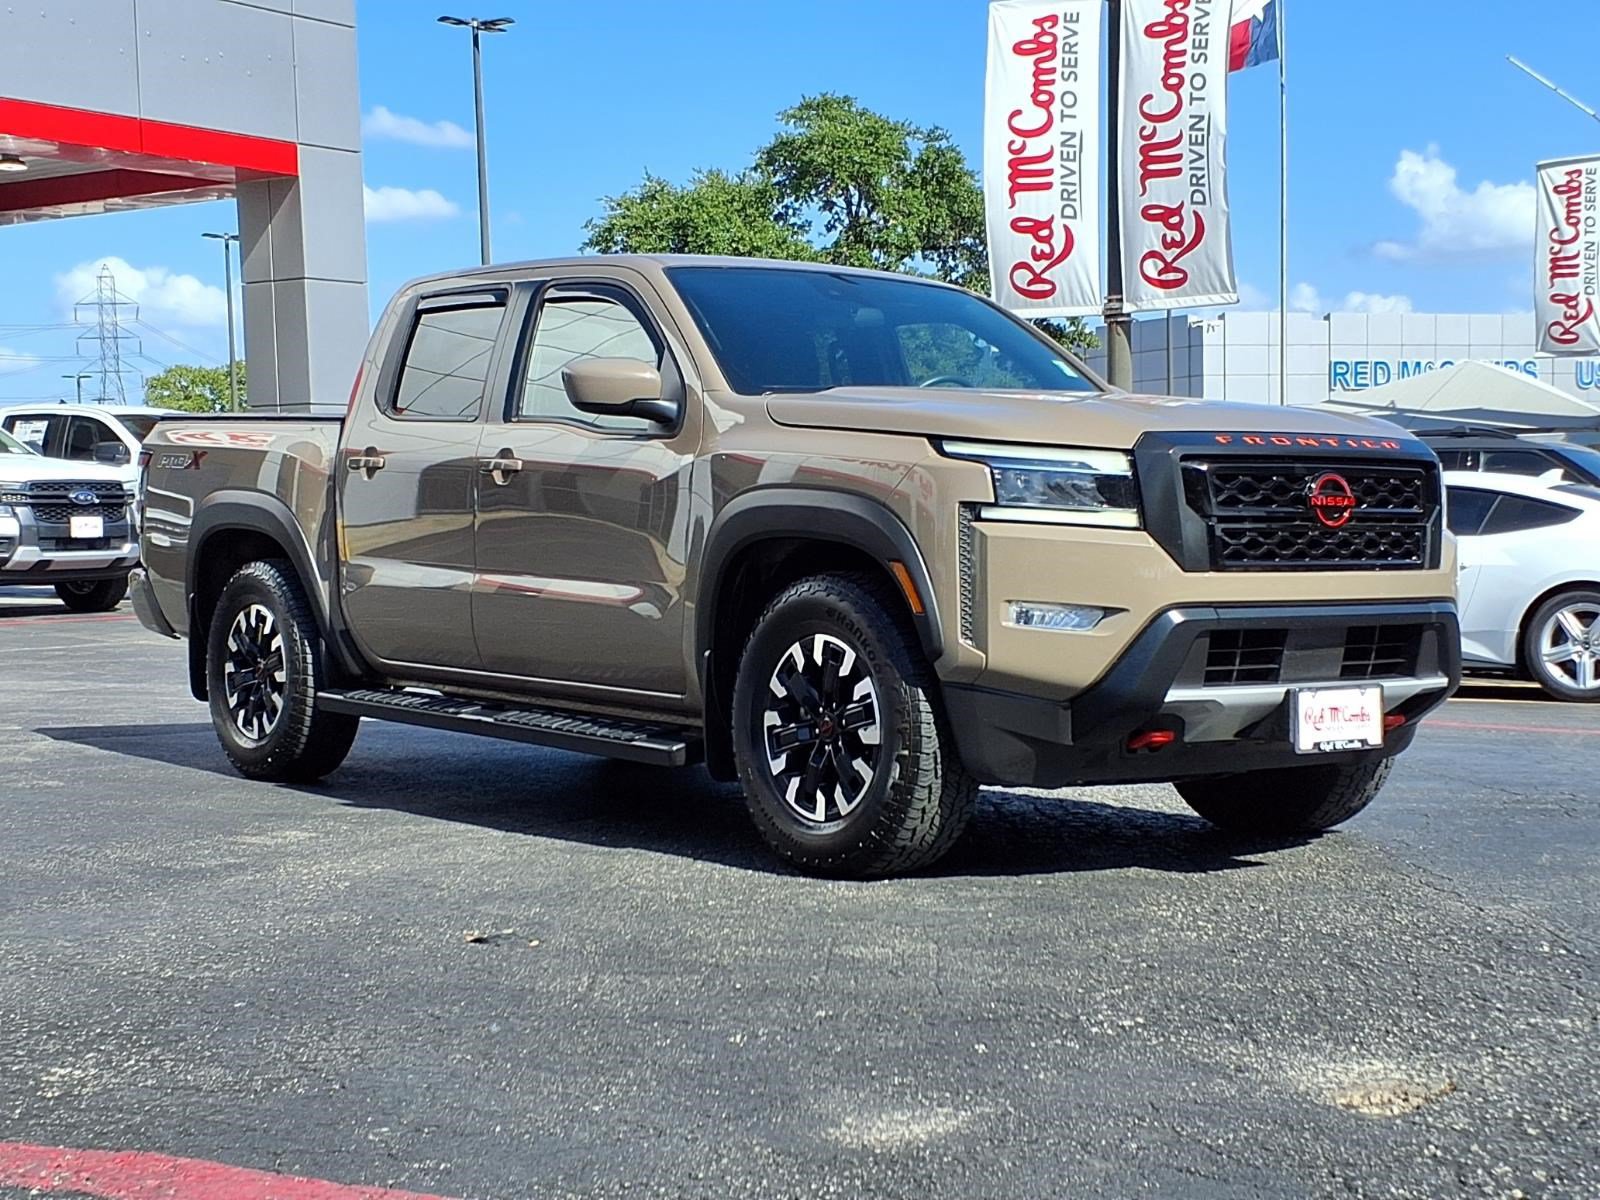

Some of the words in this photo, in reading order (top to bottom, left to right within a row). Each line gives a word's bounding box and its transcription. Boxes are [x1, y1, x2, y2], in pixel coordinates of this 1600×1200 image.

[1060, 11, 1080, 82] SERVE
[1190, 0, 1212, 64] SERV
[1007, 13, 1060, 209] McCombs
[1060, 91, 1078, 122] TO
[1138, 0, 1191, 197] McCombs
[1189, 73, 1207, 107] TO
[1060, 132, 1079, 221] DRIVEN
[1189, 114, 1208, 206] DRIVEN
[1584, 167, 1598, 212] SERVE
[1009, 214, 1074, 300] Red
[1139, 200, 1205, 290] Red
[1547, 168, 1583, 290] McCombs
[1584, 215, 1596, 236] TO
[1584, 241, 1596, 296] DRIVEN
[1547, 292, 1594, 345] Red
[1332, 361, 1391, 387] RED
[1215, 435, 1400, 449] FRONTIER
